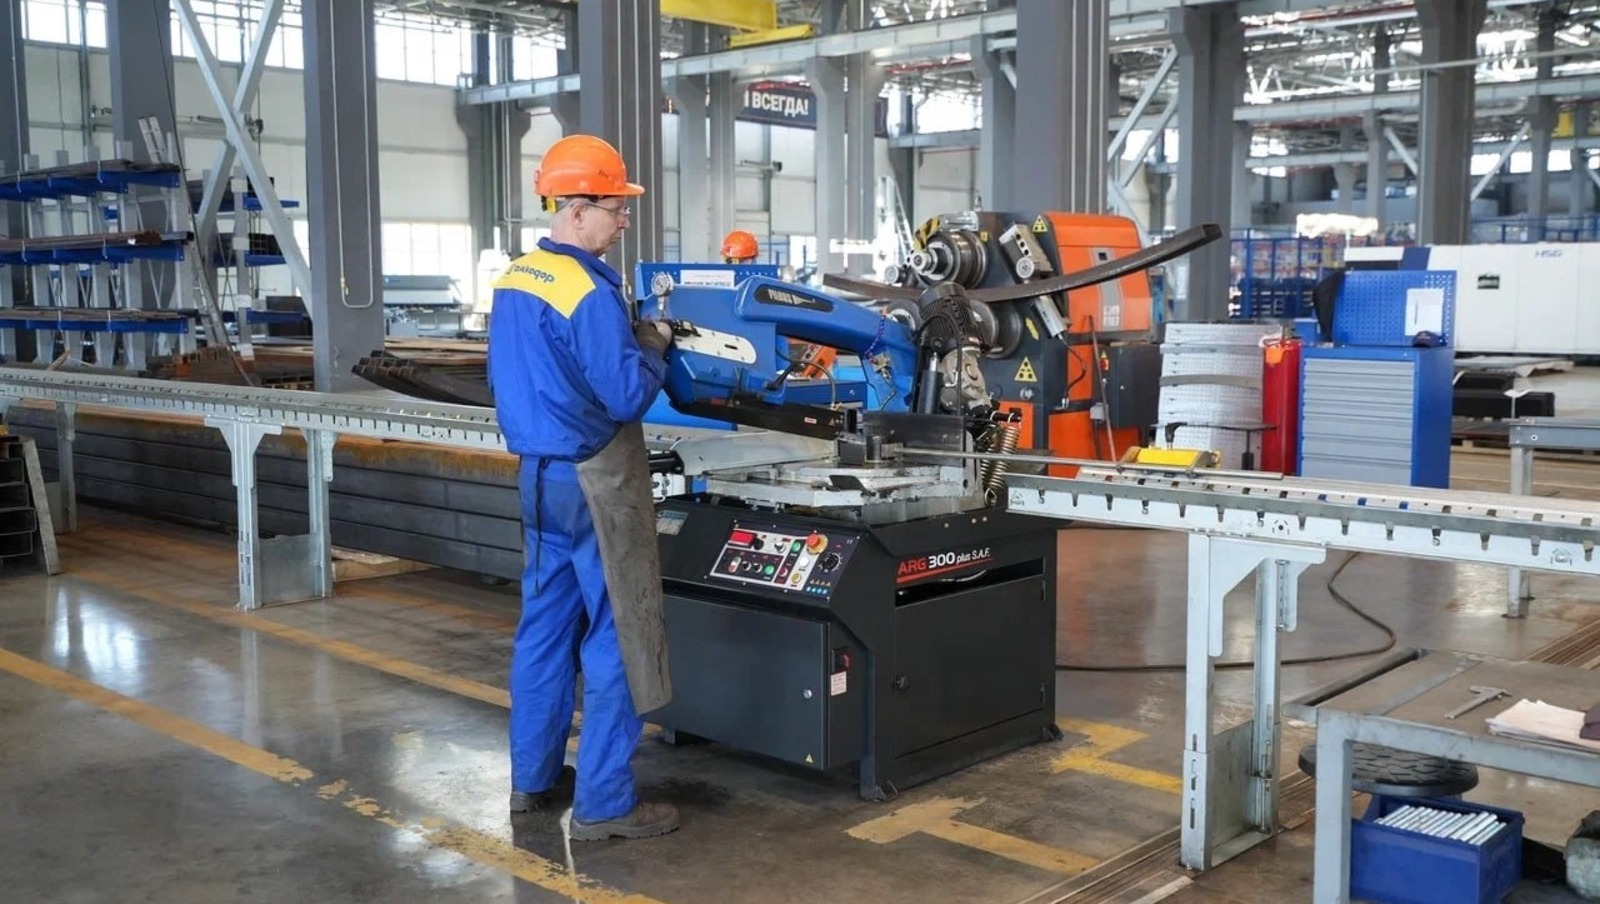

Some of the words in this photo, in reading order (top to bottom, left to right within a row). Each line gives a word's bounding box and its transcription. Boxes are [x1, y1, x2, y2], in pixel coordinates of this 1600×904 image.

[752, 91, 809, 117] ВСЕГДА!
[898, 558, 926, 575] ARG
[928, 552, 955, 569] 300
[956, 552, 971, 565] plus
[972, 547, 991, 560] S.A.F.
